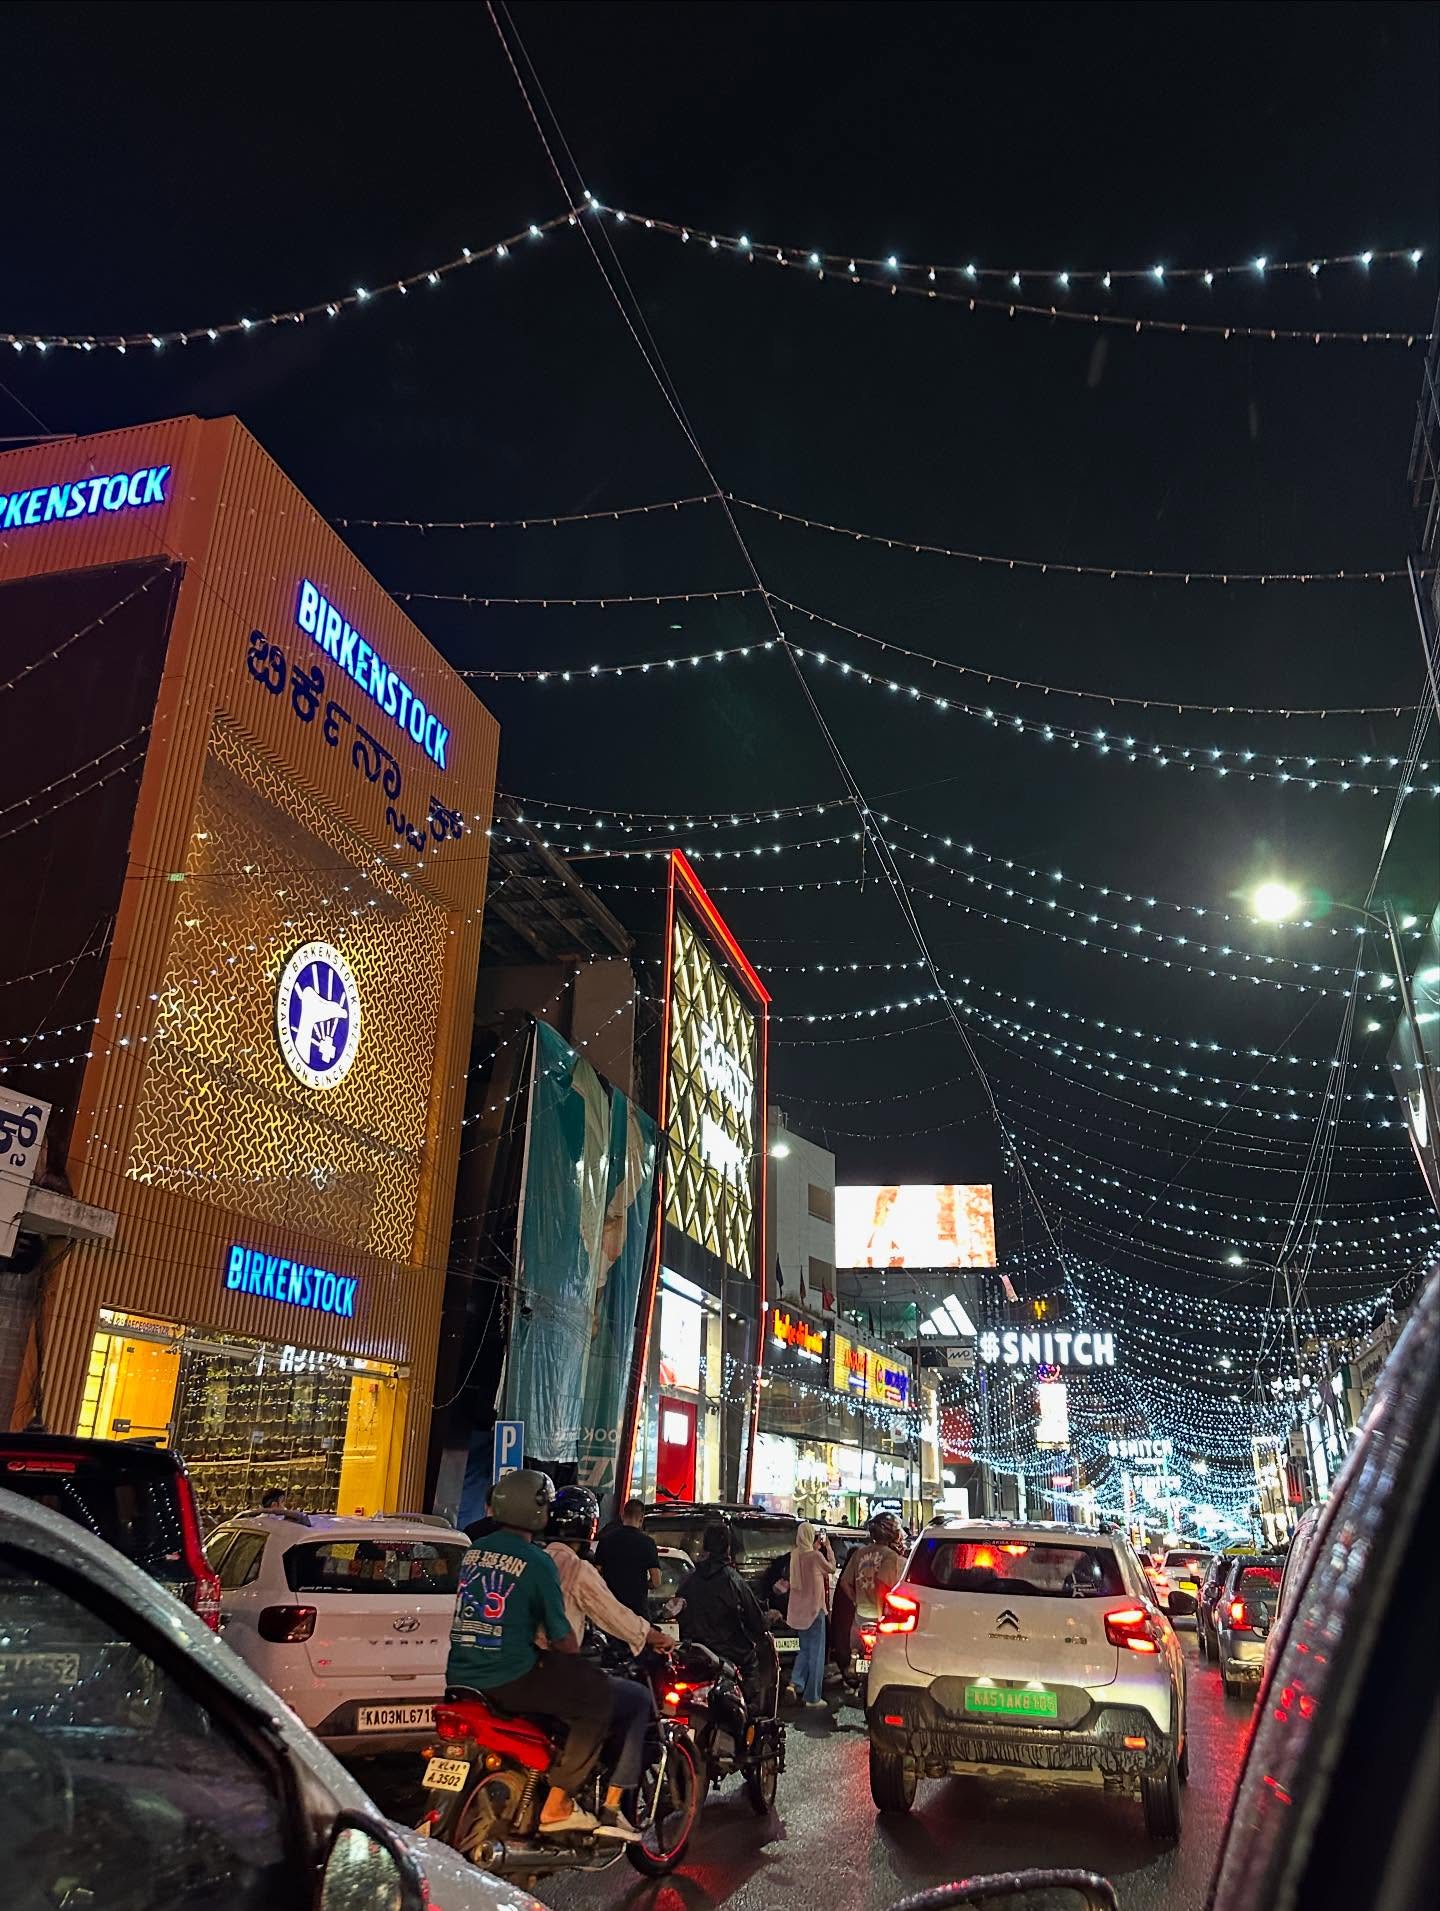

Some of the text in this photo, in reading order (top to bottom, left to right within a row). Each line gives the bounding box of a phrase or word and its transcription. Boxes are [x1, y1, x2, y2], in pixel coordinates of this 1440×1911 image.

[298, 577, 450, 771] BIRKENSTOCK
[292, 946, 358, 1004] BIRKENSTOCK
[280, 985, 308, 1081] TRADITION
[314, 1067, 345, 1087] SINCE
[225, 1244, 358, 1318] BIRKENSTOCK
[979, 1331, 1115, 1366] #SNITCH
[502, 1426, 517, 1464] P
